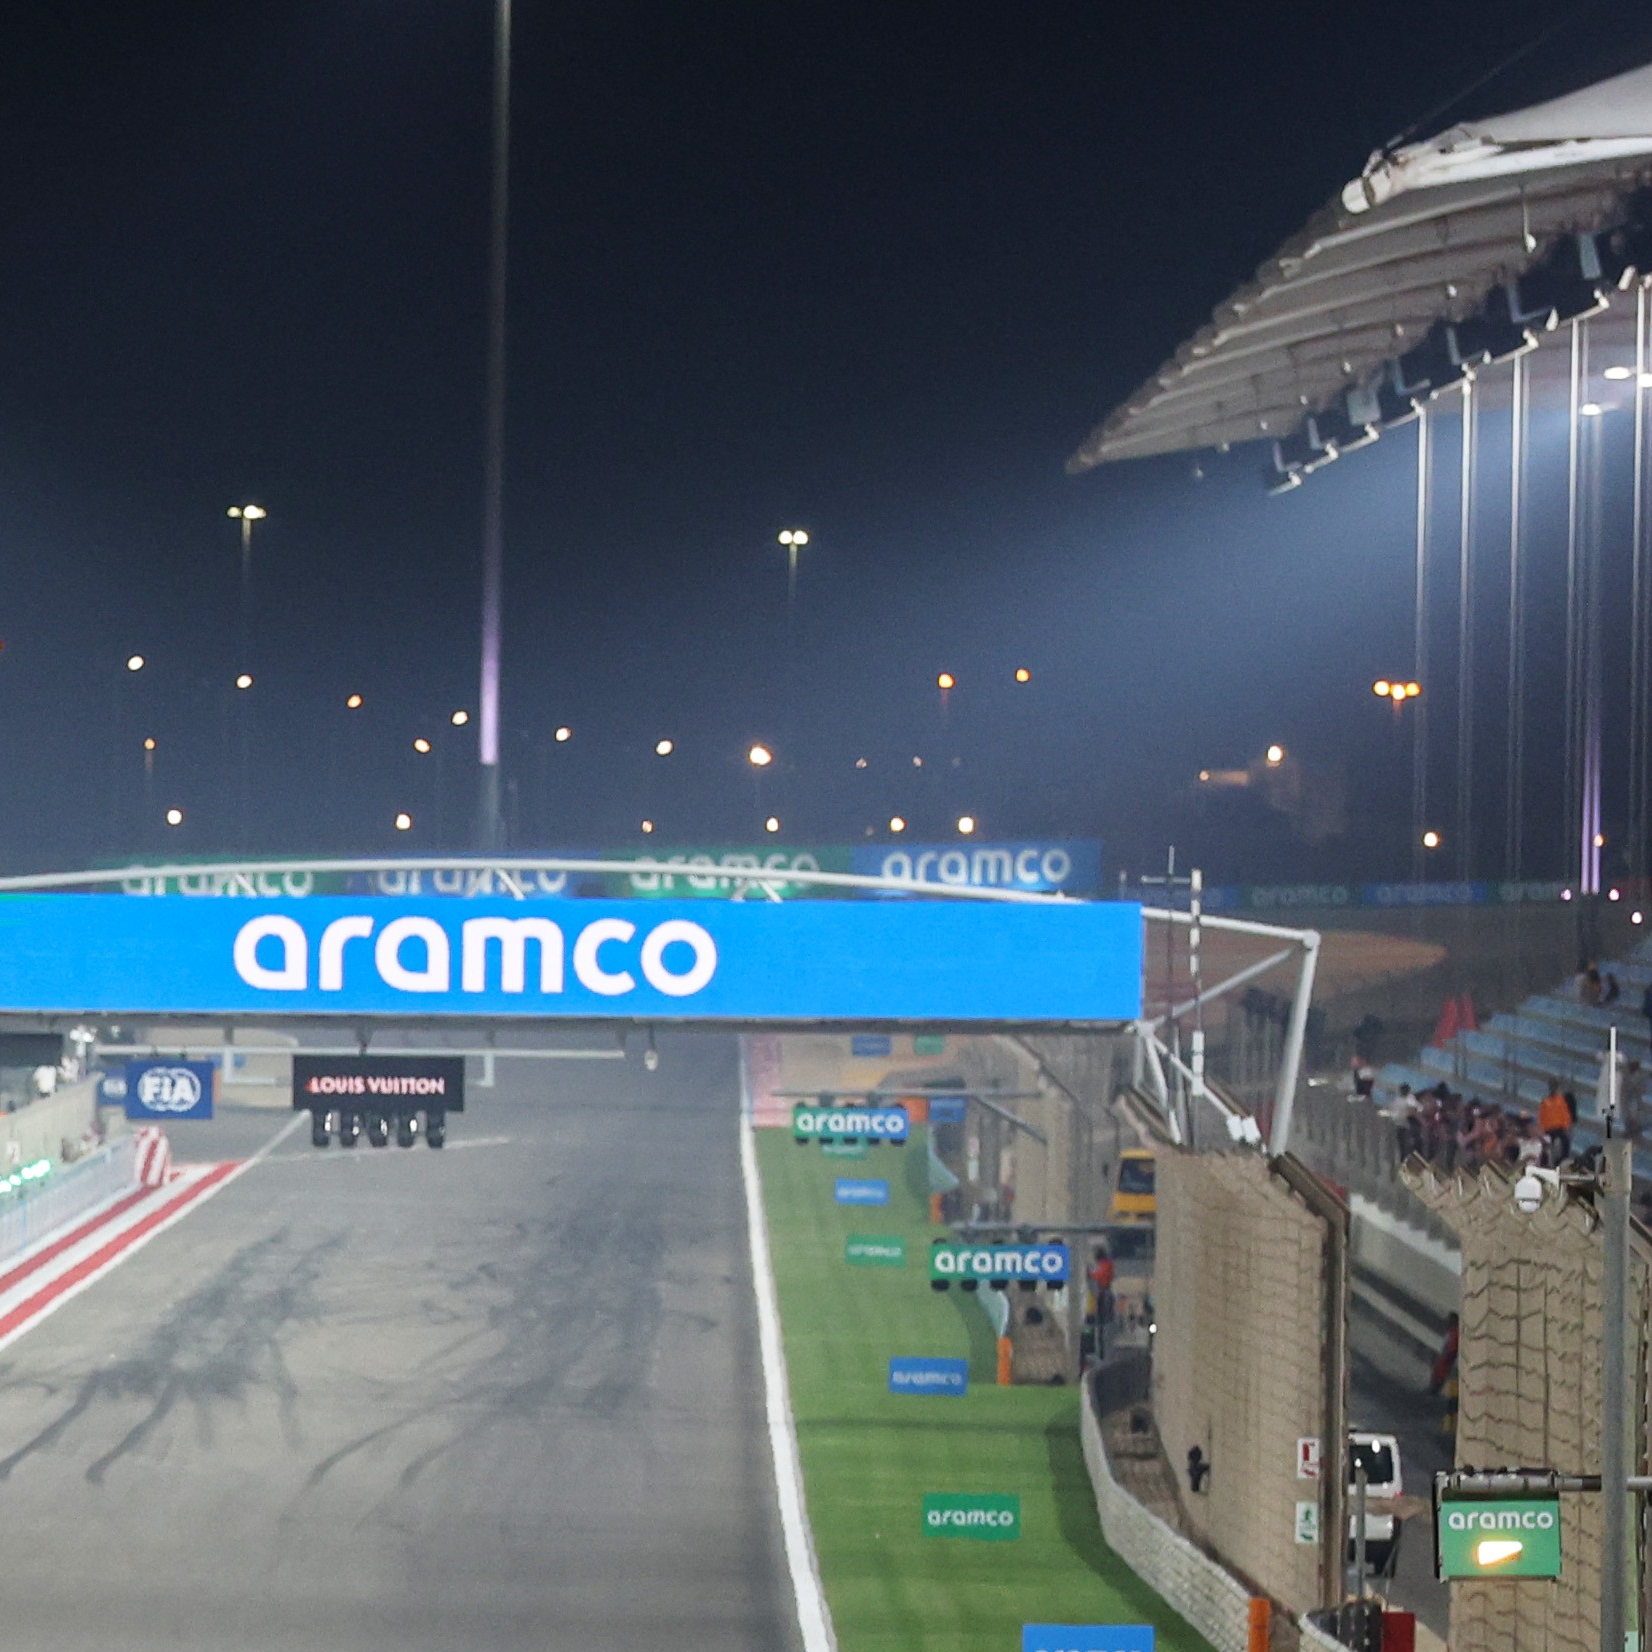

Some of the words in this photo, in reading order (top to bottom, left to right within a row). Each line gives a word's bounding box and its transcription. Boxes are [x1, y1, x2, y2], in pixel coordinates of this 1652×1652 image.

[882, 848, 1070, 885] aramco
[234, 915, 717, 997] aramco
[310, 1077, 365, 1094] LOUIS
[367, 1077, 445, 1095] VUITTON
[796, 1112, 906, 1134] aramco
[934, 1250, 1063, 1274] aramco
[927, 1509, 1015, 1527] aramco
[1448, 1511, 1554, 1530] aramco
